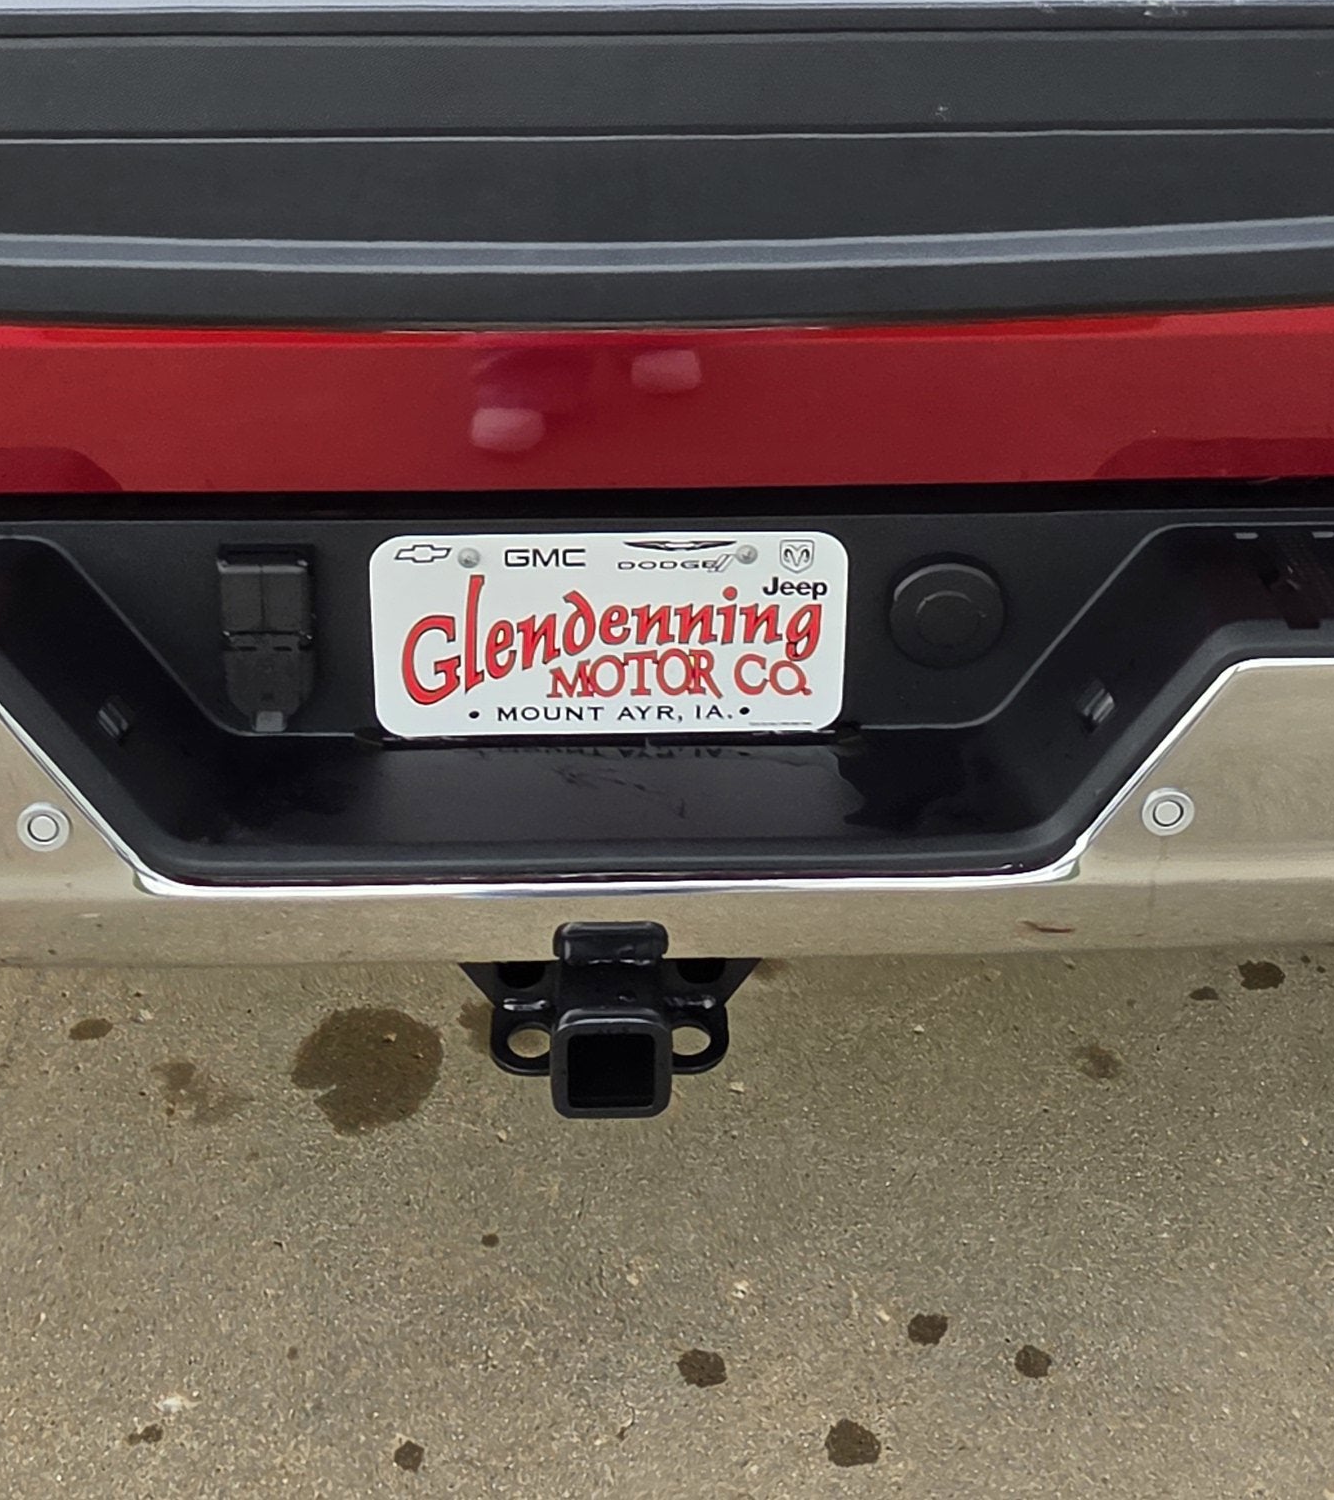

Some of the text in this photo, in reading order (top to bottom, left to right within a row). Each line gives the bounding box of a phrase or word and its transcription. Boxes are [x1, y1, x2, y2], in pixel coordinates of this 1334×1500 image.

[503, 548, 586, 568] GMC
[617, 560, 716, 571] DODGE
[762, 577, 828, 599] Jeep
[402, 574, 823, 706] Glendenning
[547, 648, 722, 699] MOTOR
[497, 704, 733, 722] MOUNT AYR, IA.
